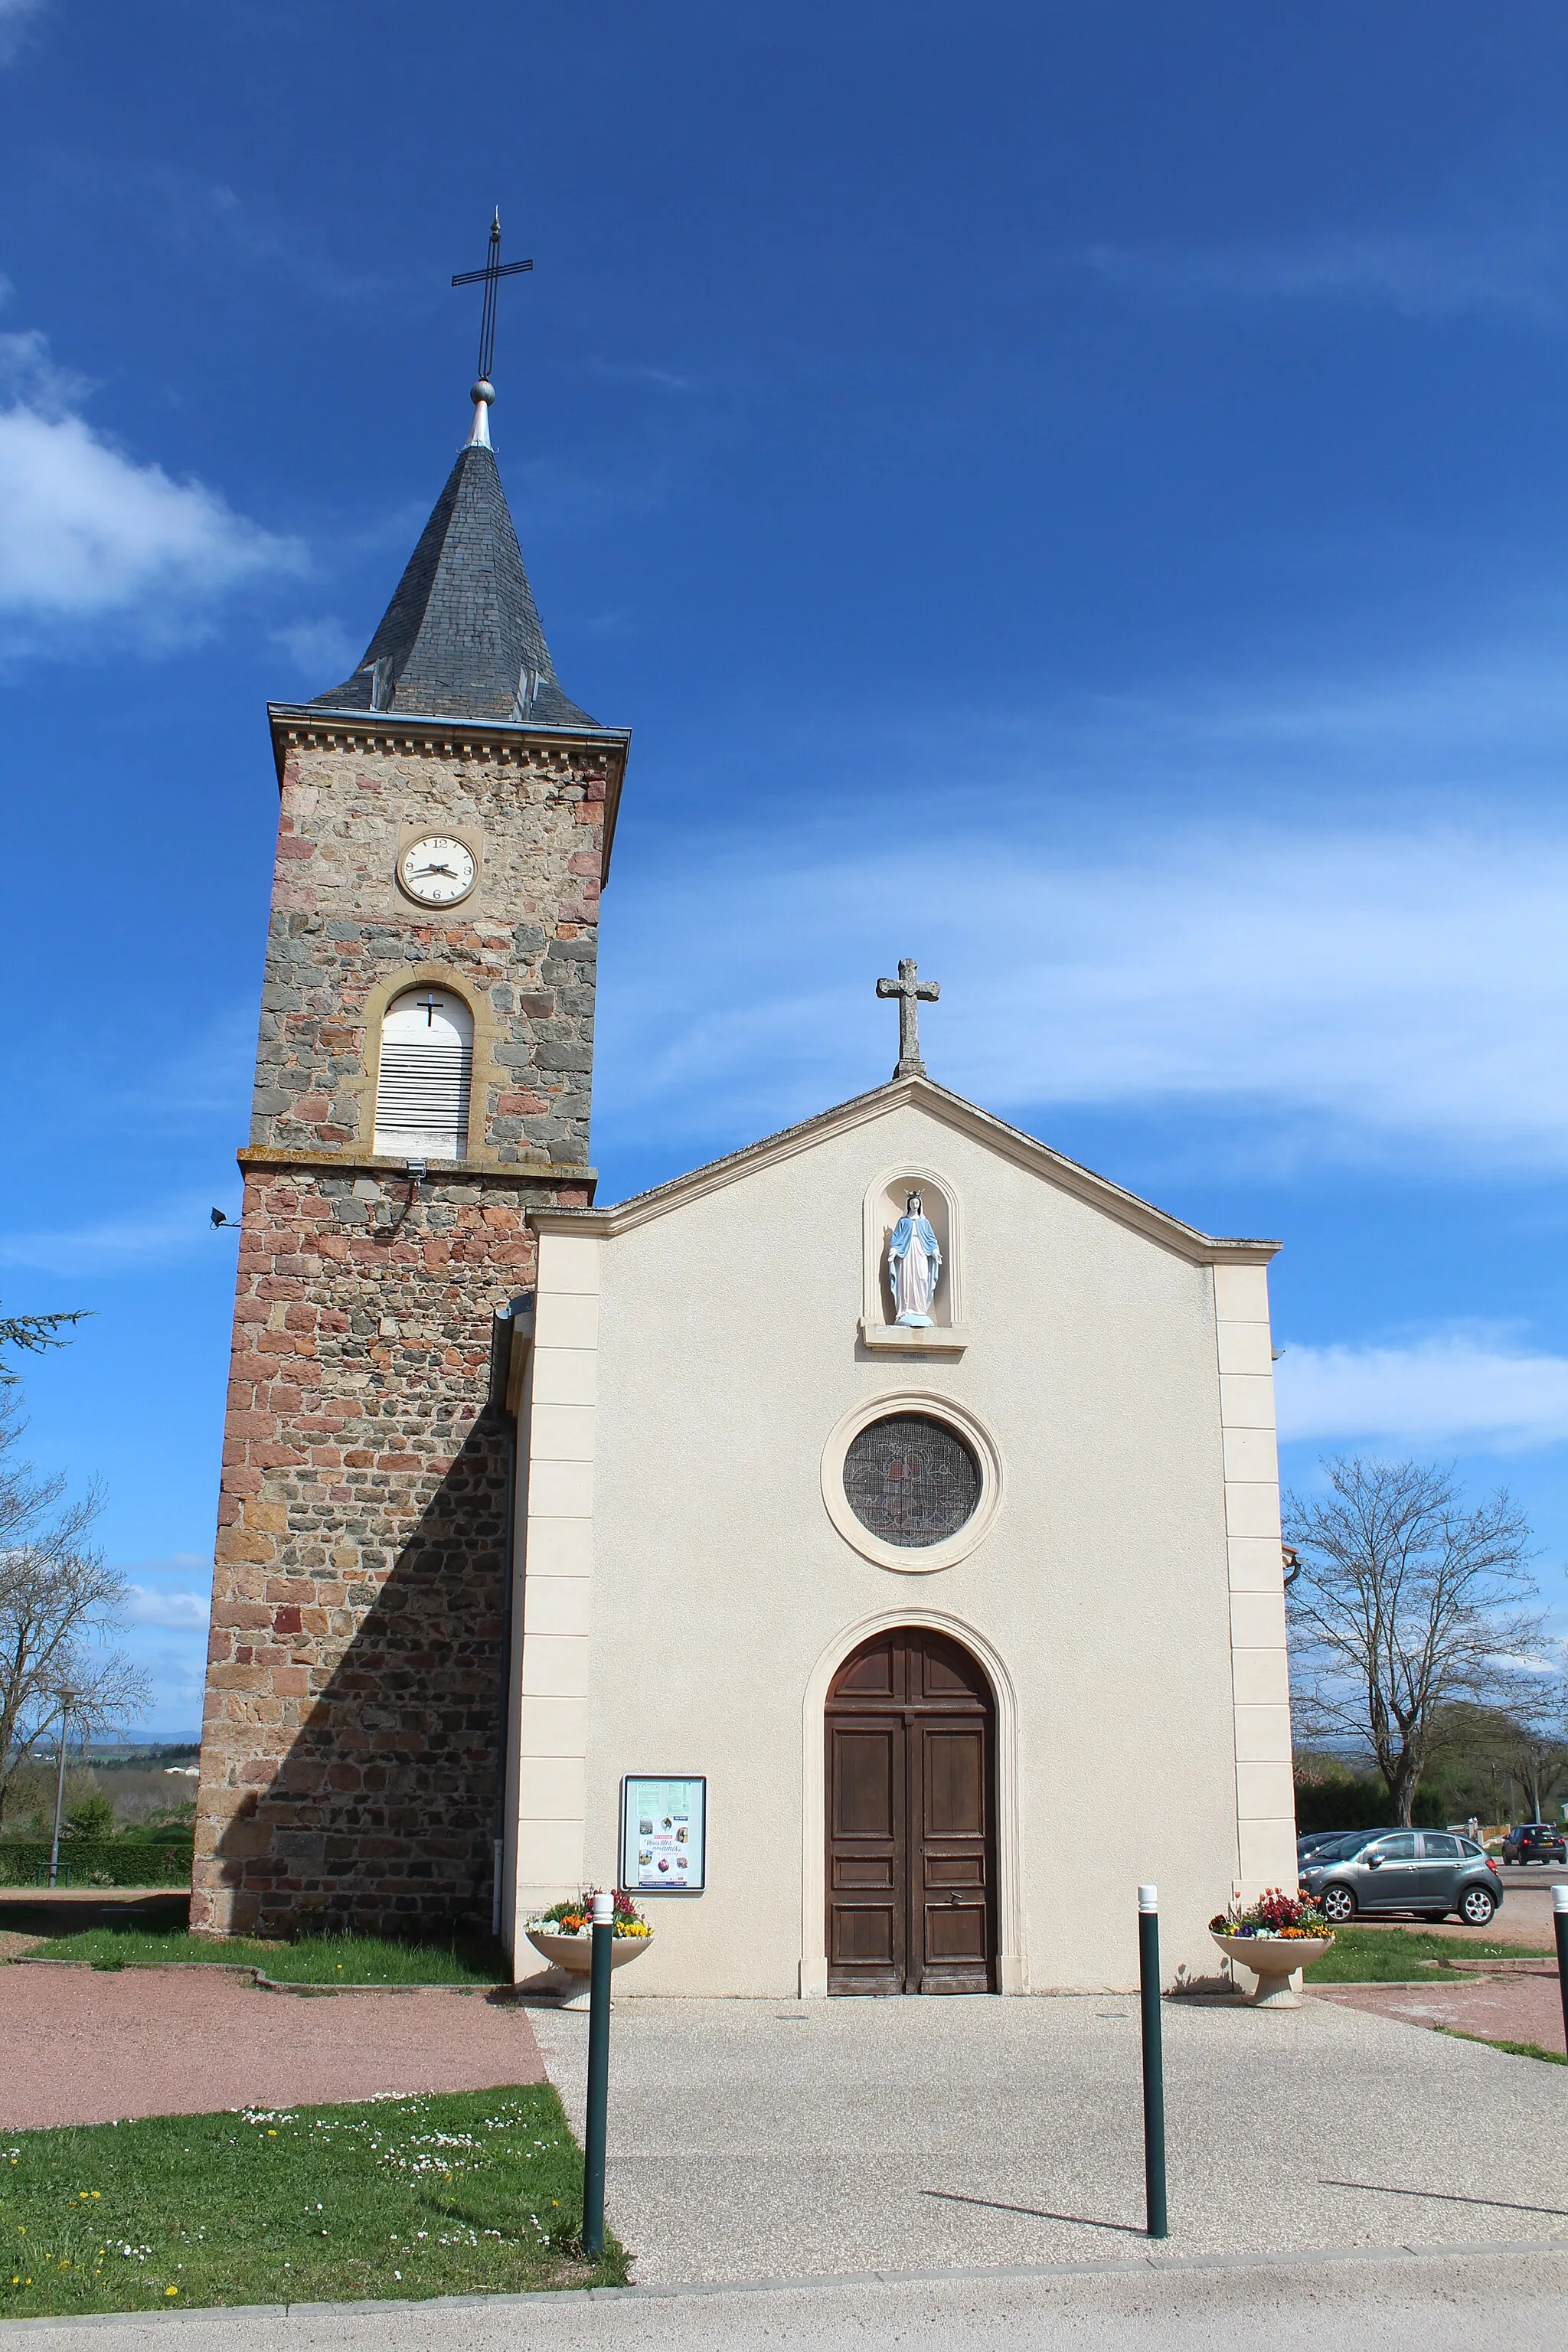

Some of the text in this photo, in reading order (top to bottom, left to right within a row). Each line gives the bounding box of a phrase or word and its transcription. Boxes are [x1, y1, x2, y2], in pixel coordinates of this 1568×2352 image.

[432, 838, 448, 849] 12
[405, 862, 413, 871] 9
[463, 866, 472, 876] 3
[433, 889, 442, 899] 6
